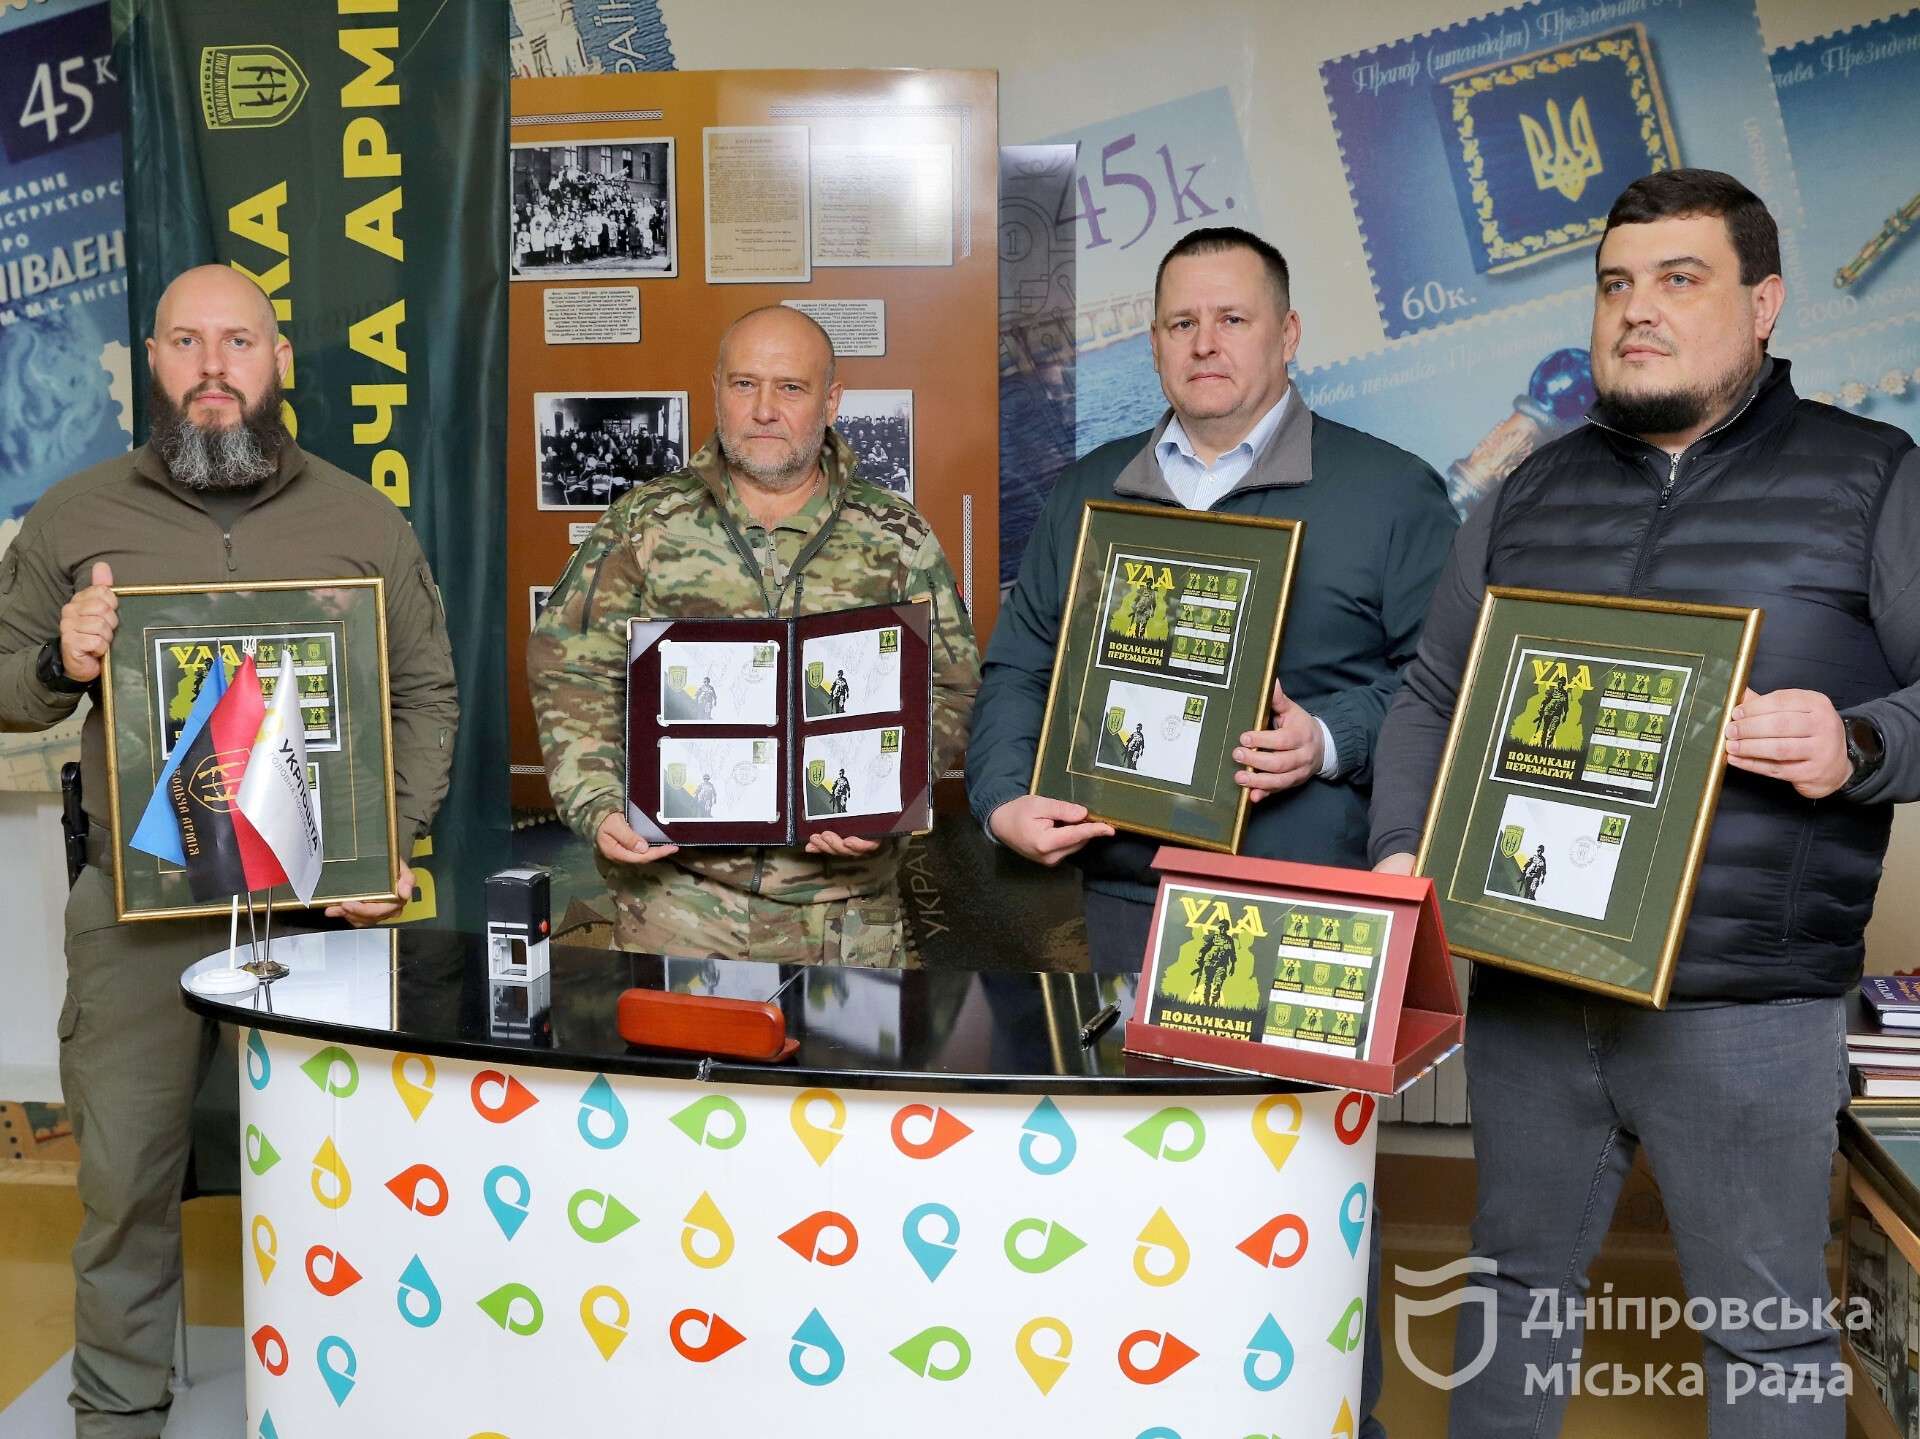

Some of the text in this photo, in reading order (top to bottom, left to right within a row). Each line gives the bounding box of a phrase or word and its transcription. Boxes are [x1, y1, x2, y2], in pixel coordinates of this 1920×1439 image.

[0, 179, 125, 230] СТРУКТОРС
[1107, 650, 1162, 666] ПЕРЕМАГАТИ
[1109, 641, 1164, 658] ПОКЛИКАНІ
[1505, 761, 1574, 780] ПЕРЕМАГАТИ
[1508, 751, 1577, 770] ПОКЛИКАНІ
[278, 738, 319, 851] УКРПОШТА
[182, 817, 200, 856] АРМІЯ
[1161, 1010, 1252, 1033] ПОКЛИКАНІ
